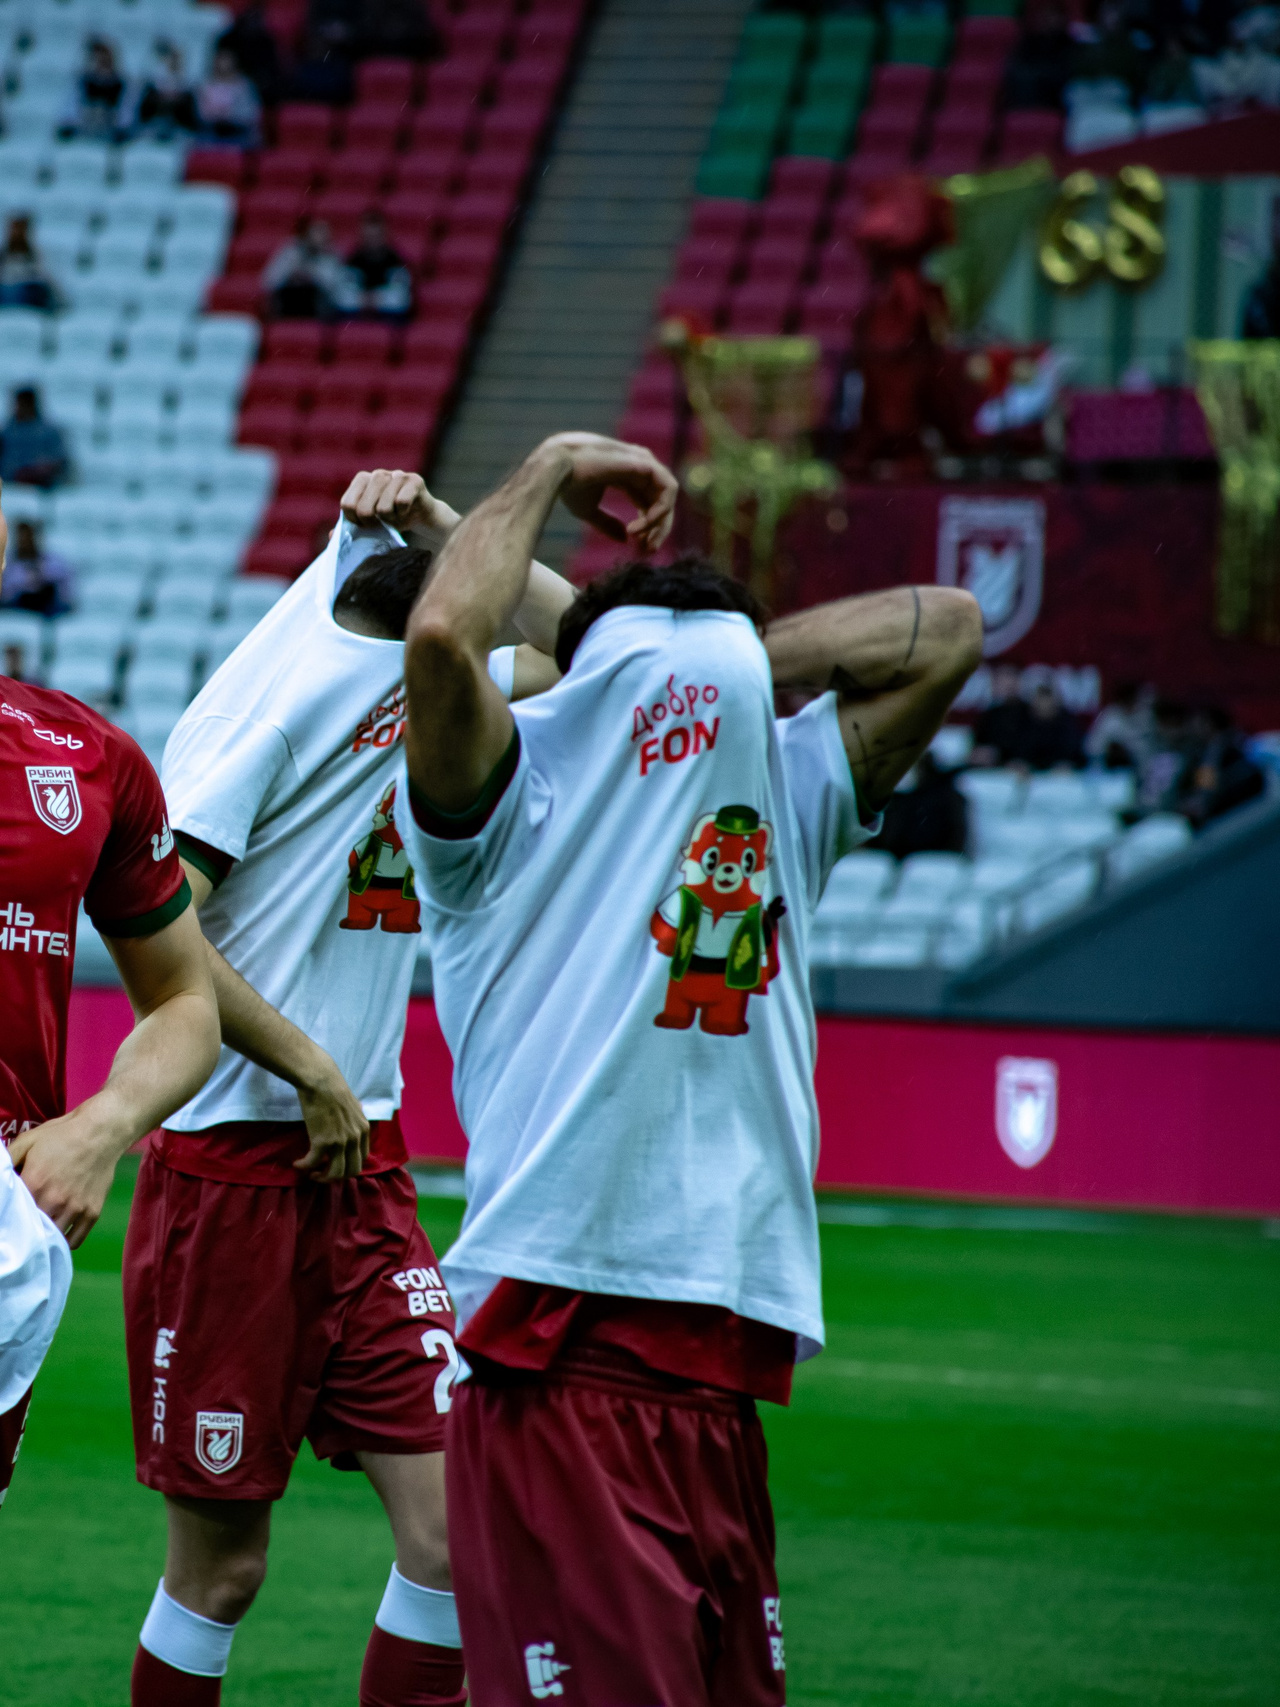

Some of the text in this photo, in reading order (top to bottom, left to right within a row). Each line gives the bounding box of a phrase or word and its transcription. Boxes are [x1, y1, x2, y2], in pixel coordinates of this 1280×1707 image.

[640, 716, 721, 776] FON
[28, 769, 72, 779] РУБИН
[392, 1266, 443, 1292] FON
[407, 1289, 452, 1317] BET
